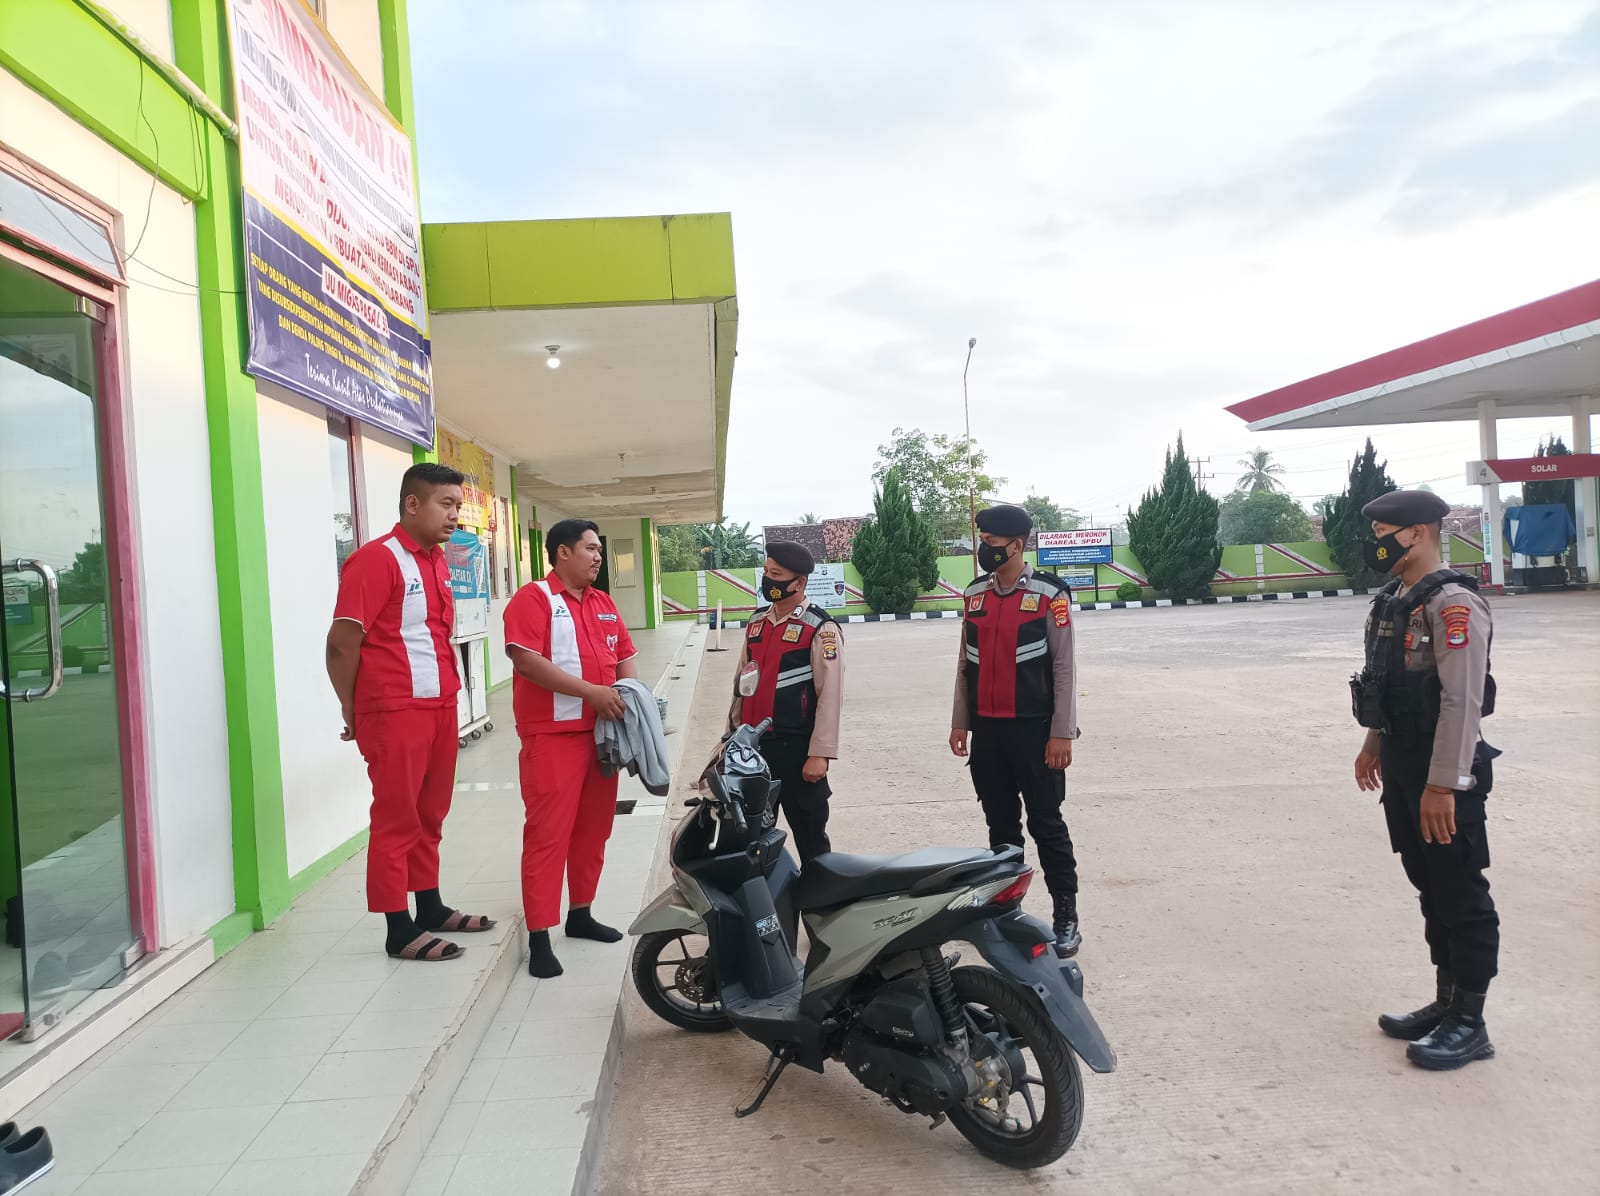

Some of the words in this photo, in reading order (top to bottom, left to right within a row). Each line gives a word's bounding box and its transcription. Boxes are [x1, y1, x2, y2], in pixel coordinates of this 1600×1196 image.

[263, 0, 384, 173] IMBAUAN
[325, 270, 335, 294] UU
[337, 280, 359, 313] MIGAS
[360, 300, 381, 329] PASAL
[304, 352, 331, 387] Terima
[1480, 468, 1487, 477] 4
[1531, 464, 1558, 473] SOLAR
